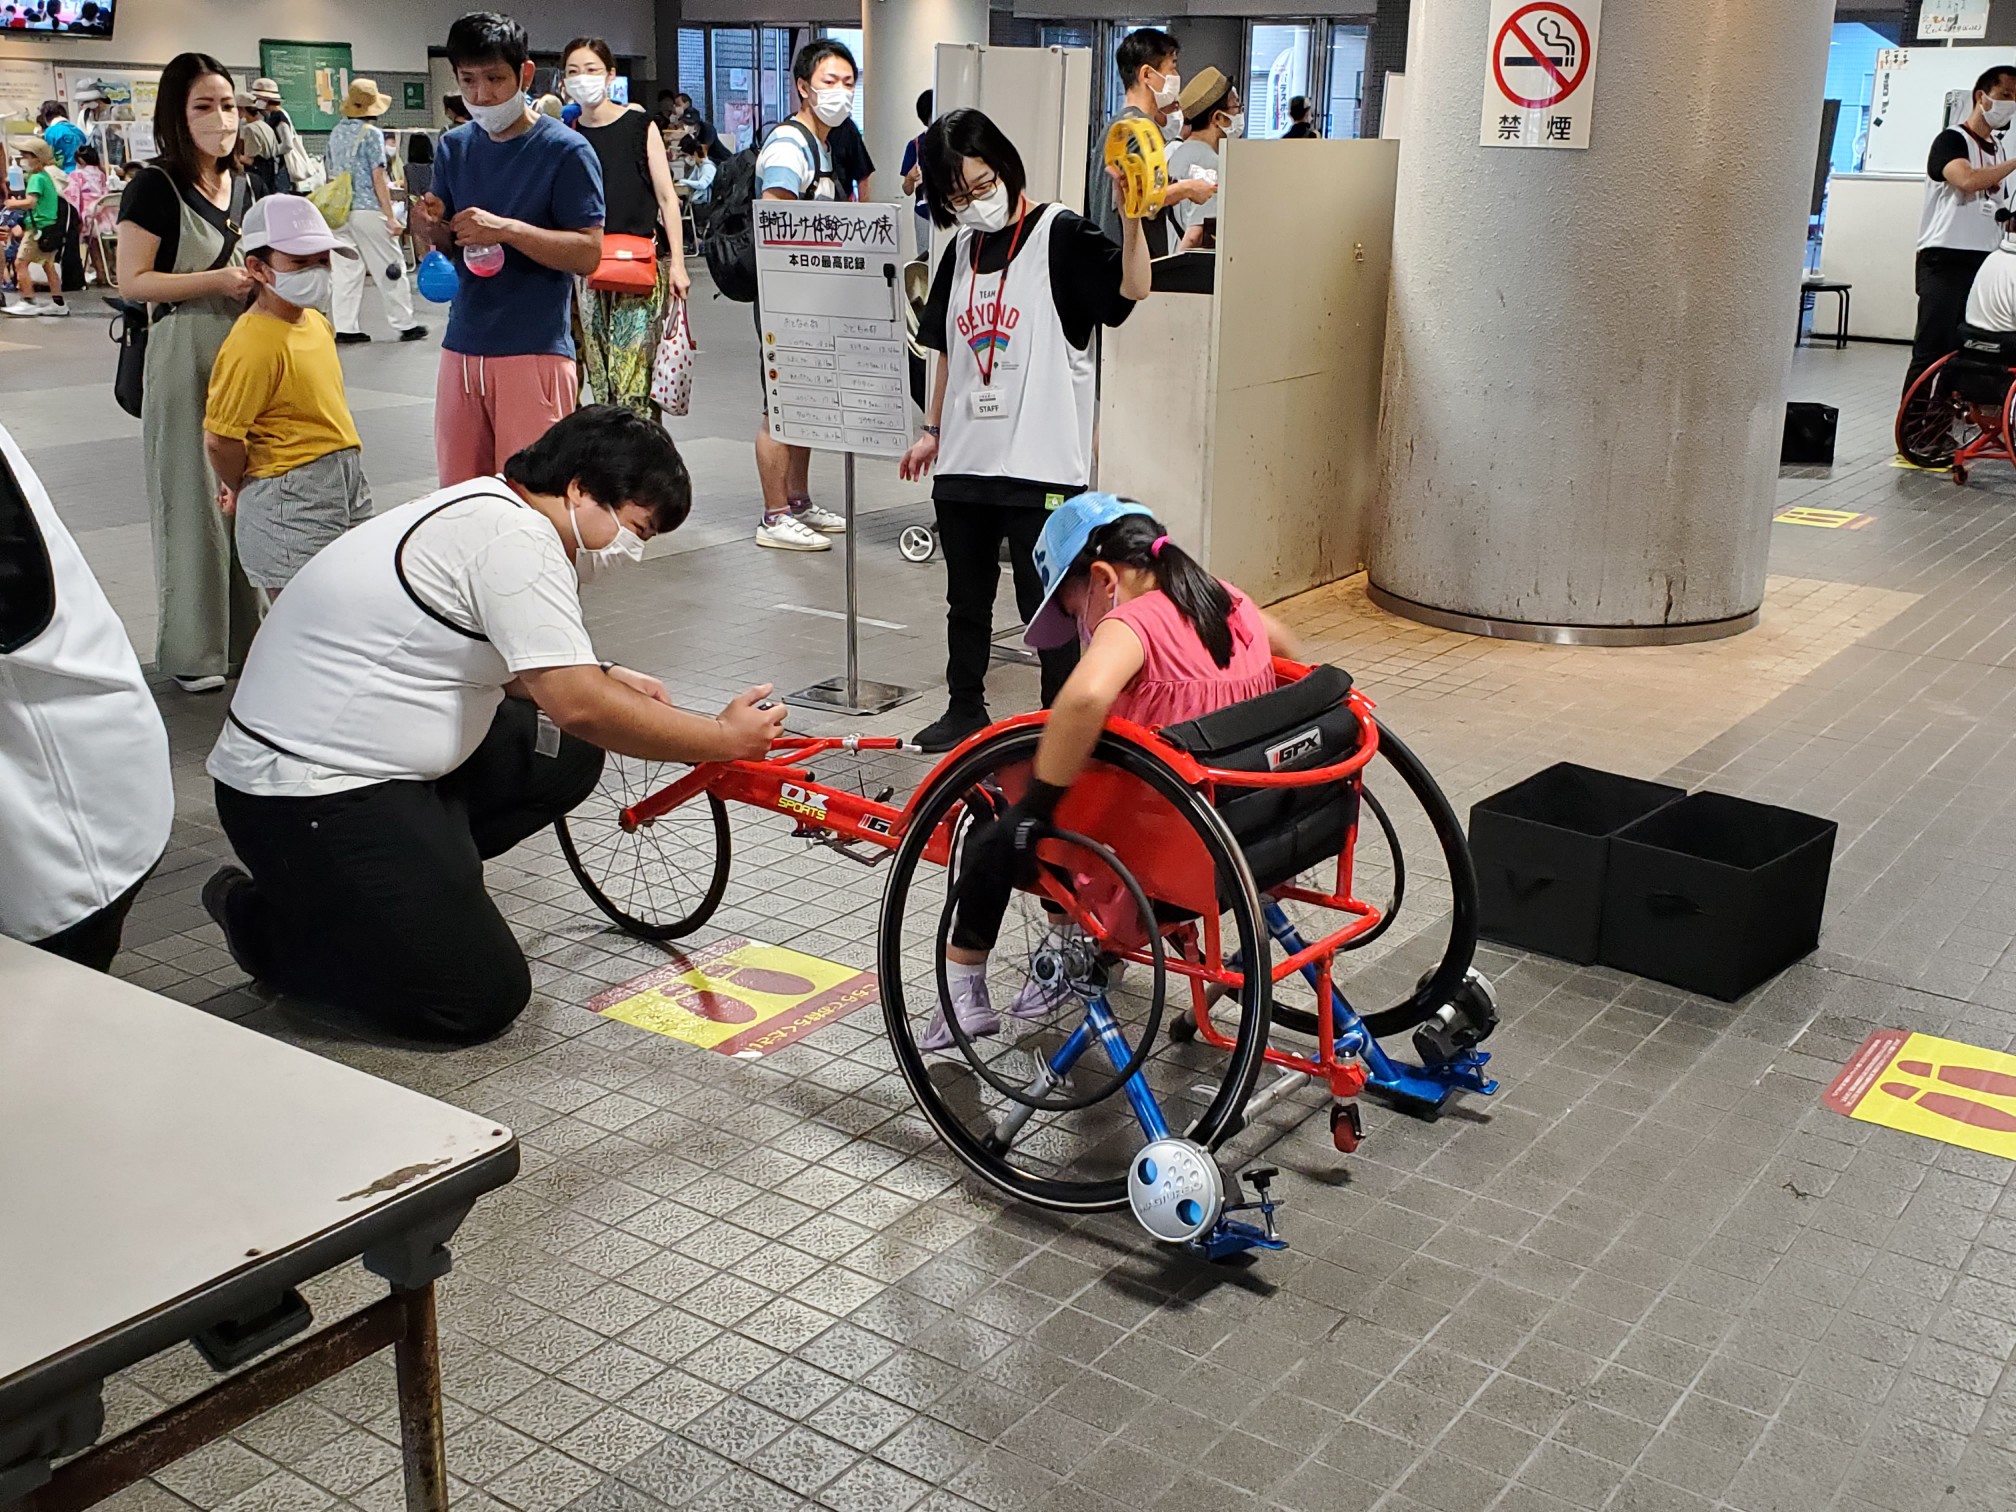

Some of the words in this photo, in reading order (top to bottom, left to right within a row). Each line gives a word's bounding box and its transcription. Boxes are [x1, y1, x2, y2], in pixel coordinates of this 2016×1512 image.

[1498, 114, 1572, 140] 禁煙
[788, 253, 866, 270] 本日の最高記録
[980, 290, 996, 299] TEAM
[957, 302, 1020, 336] BEYOND
[979, 404, 999, 413] STAFF
[1279, 733, 1319, 763] GPX
[778, 797, 827, 821] SPORTS
[780, 783, 830, 810] OX
